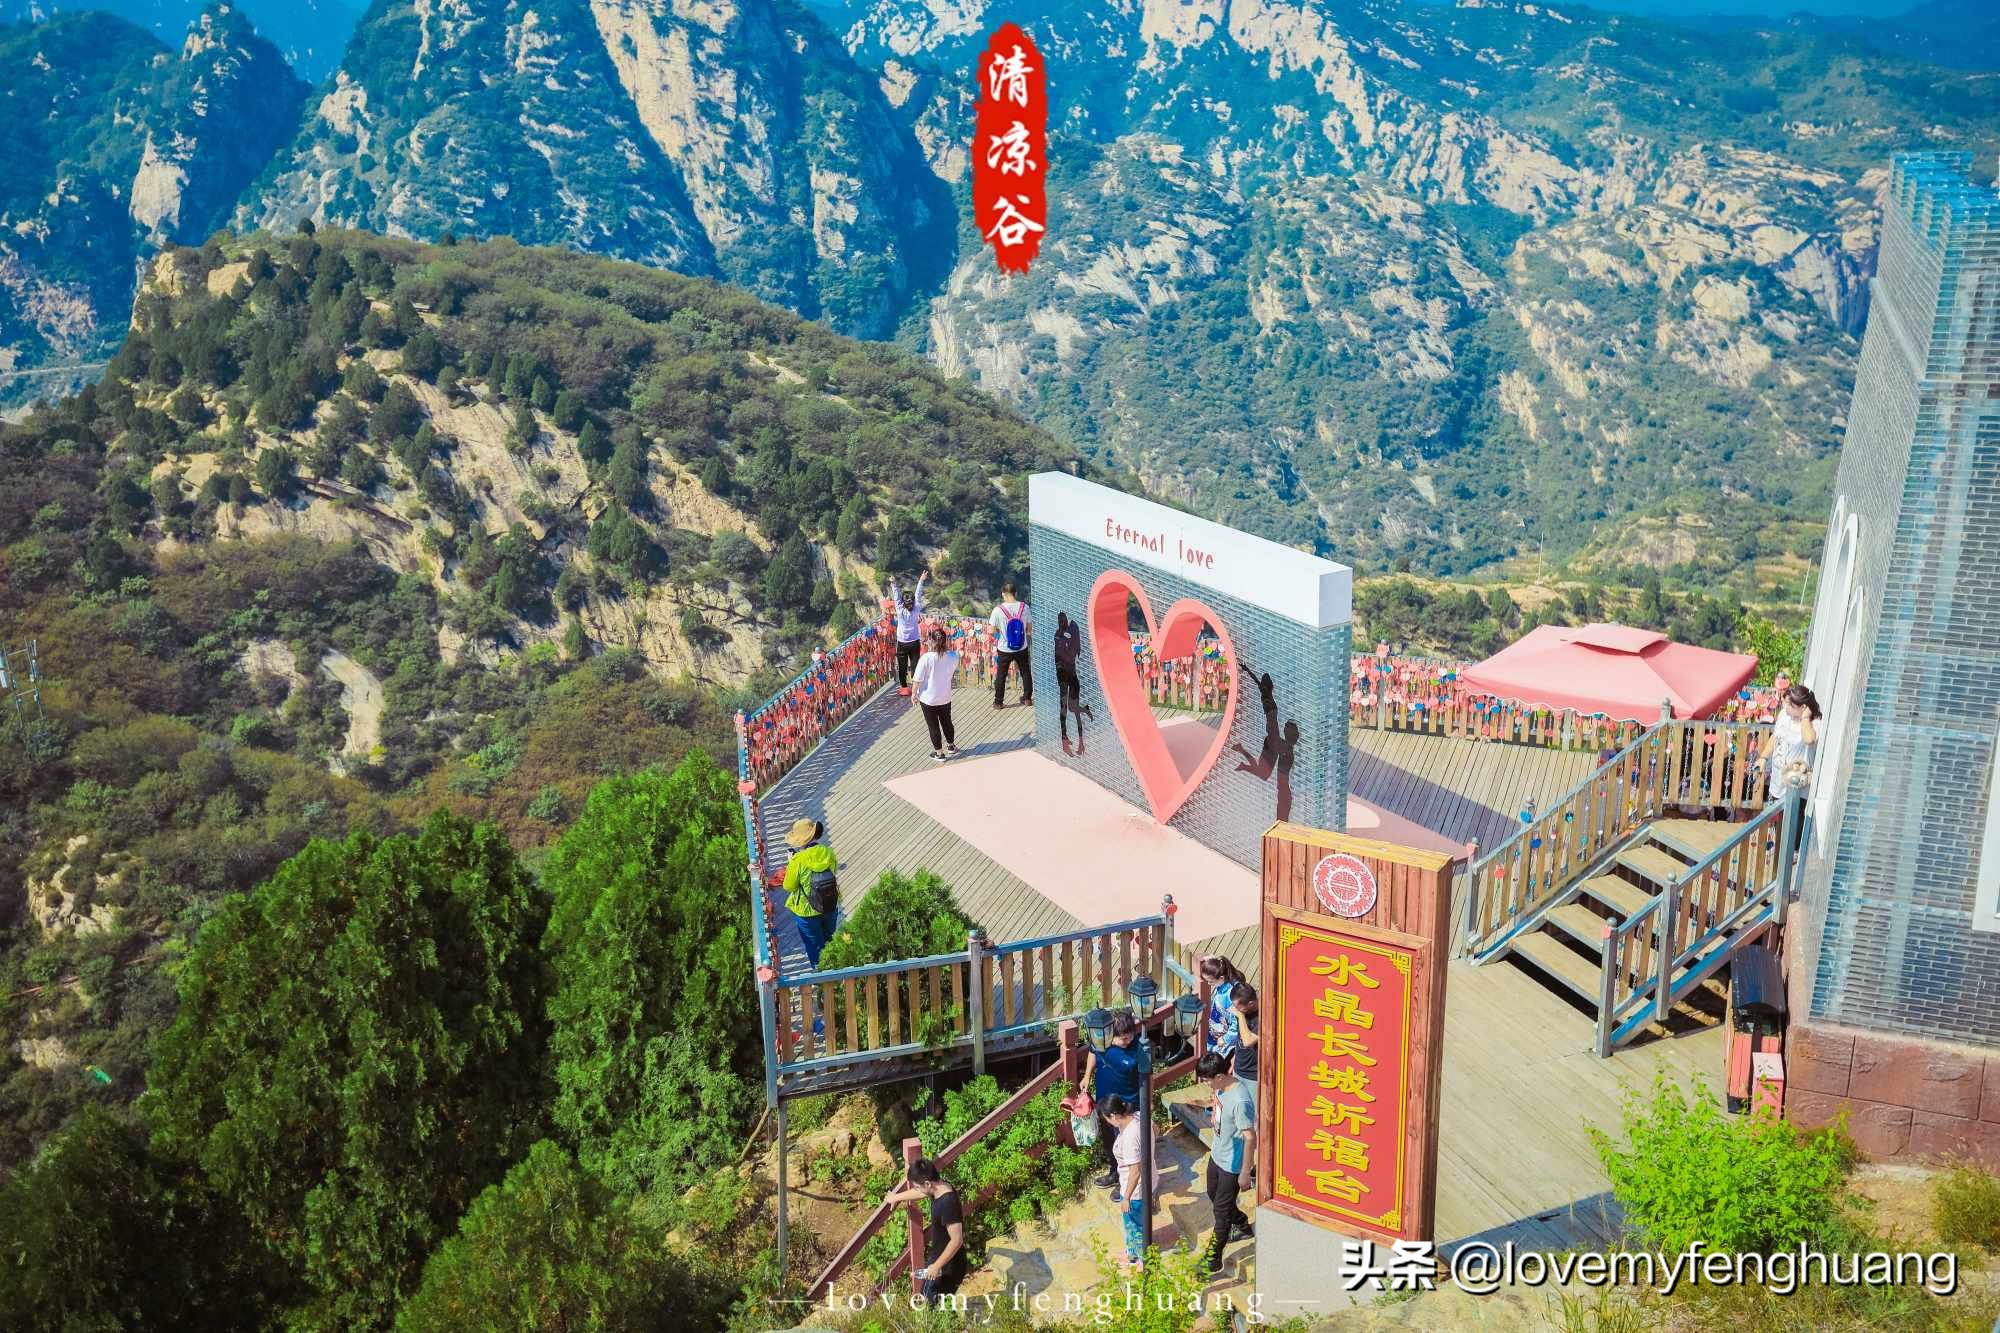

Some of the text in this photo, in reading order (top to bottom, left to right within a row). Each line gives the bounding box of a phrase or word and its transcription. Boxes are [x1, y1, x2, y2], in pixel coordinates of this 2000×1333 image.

[1106, 518, 1214, 569] Eternal love
[1304, 953, 1381, 1204] 水晶长城祈福台
